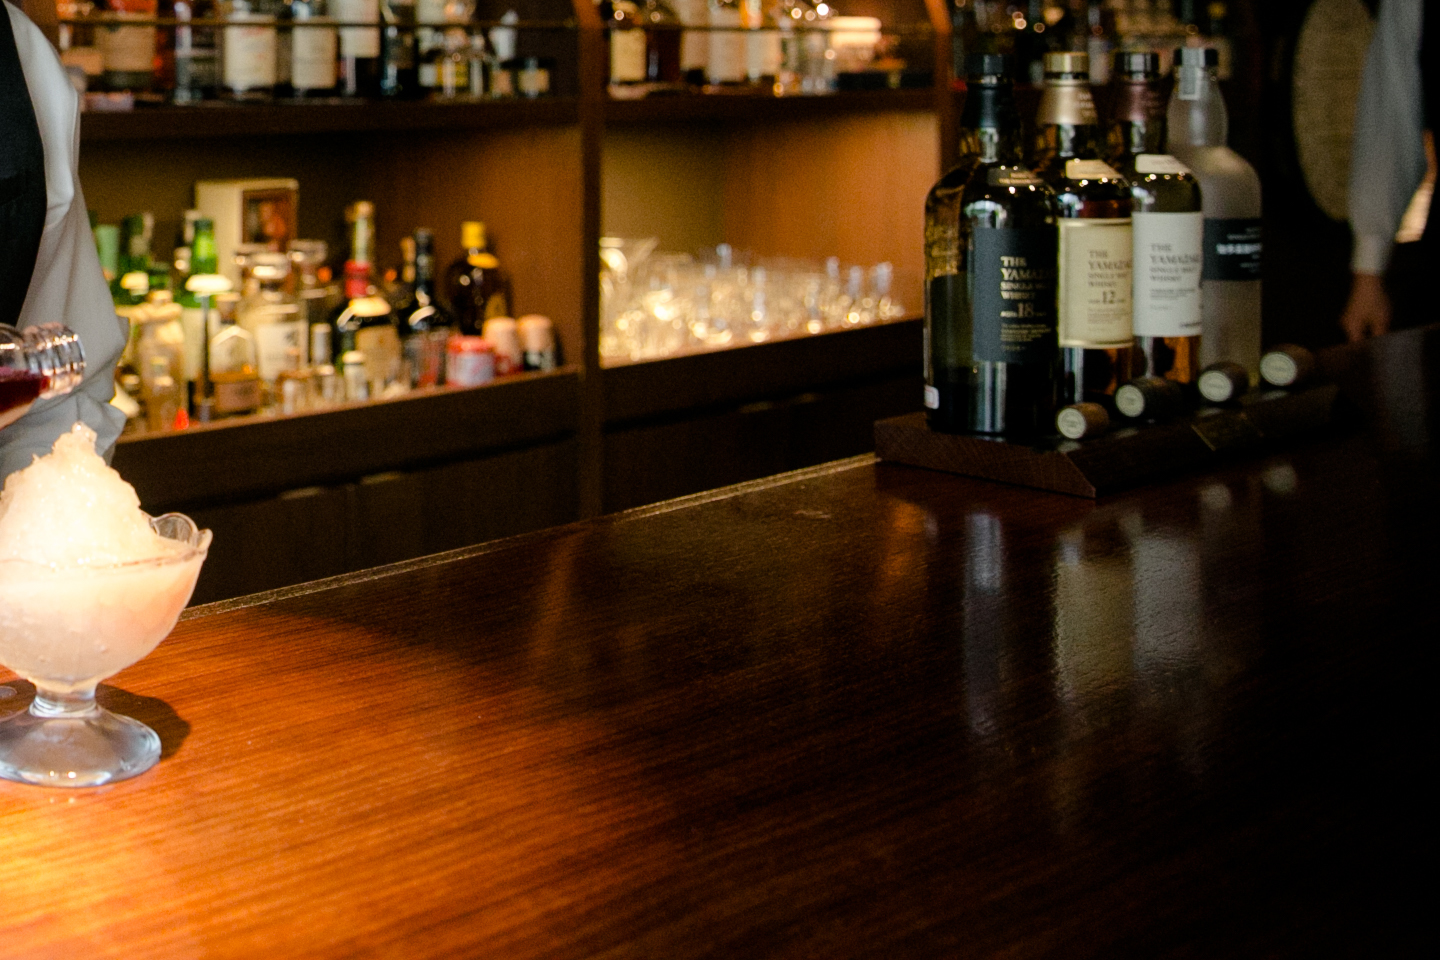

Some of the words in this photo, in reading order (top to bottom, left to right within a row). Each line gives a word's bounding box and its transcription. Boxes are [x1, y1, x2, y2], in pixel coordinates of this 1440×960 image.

[1000, 256, 1027, 267] THE
[1102, 290, 1117, 305] 12
[1017, 302, 1035, 318] 18
